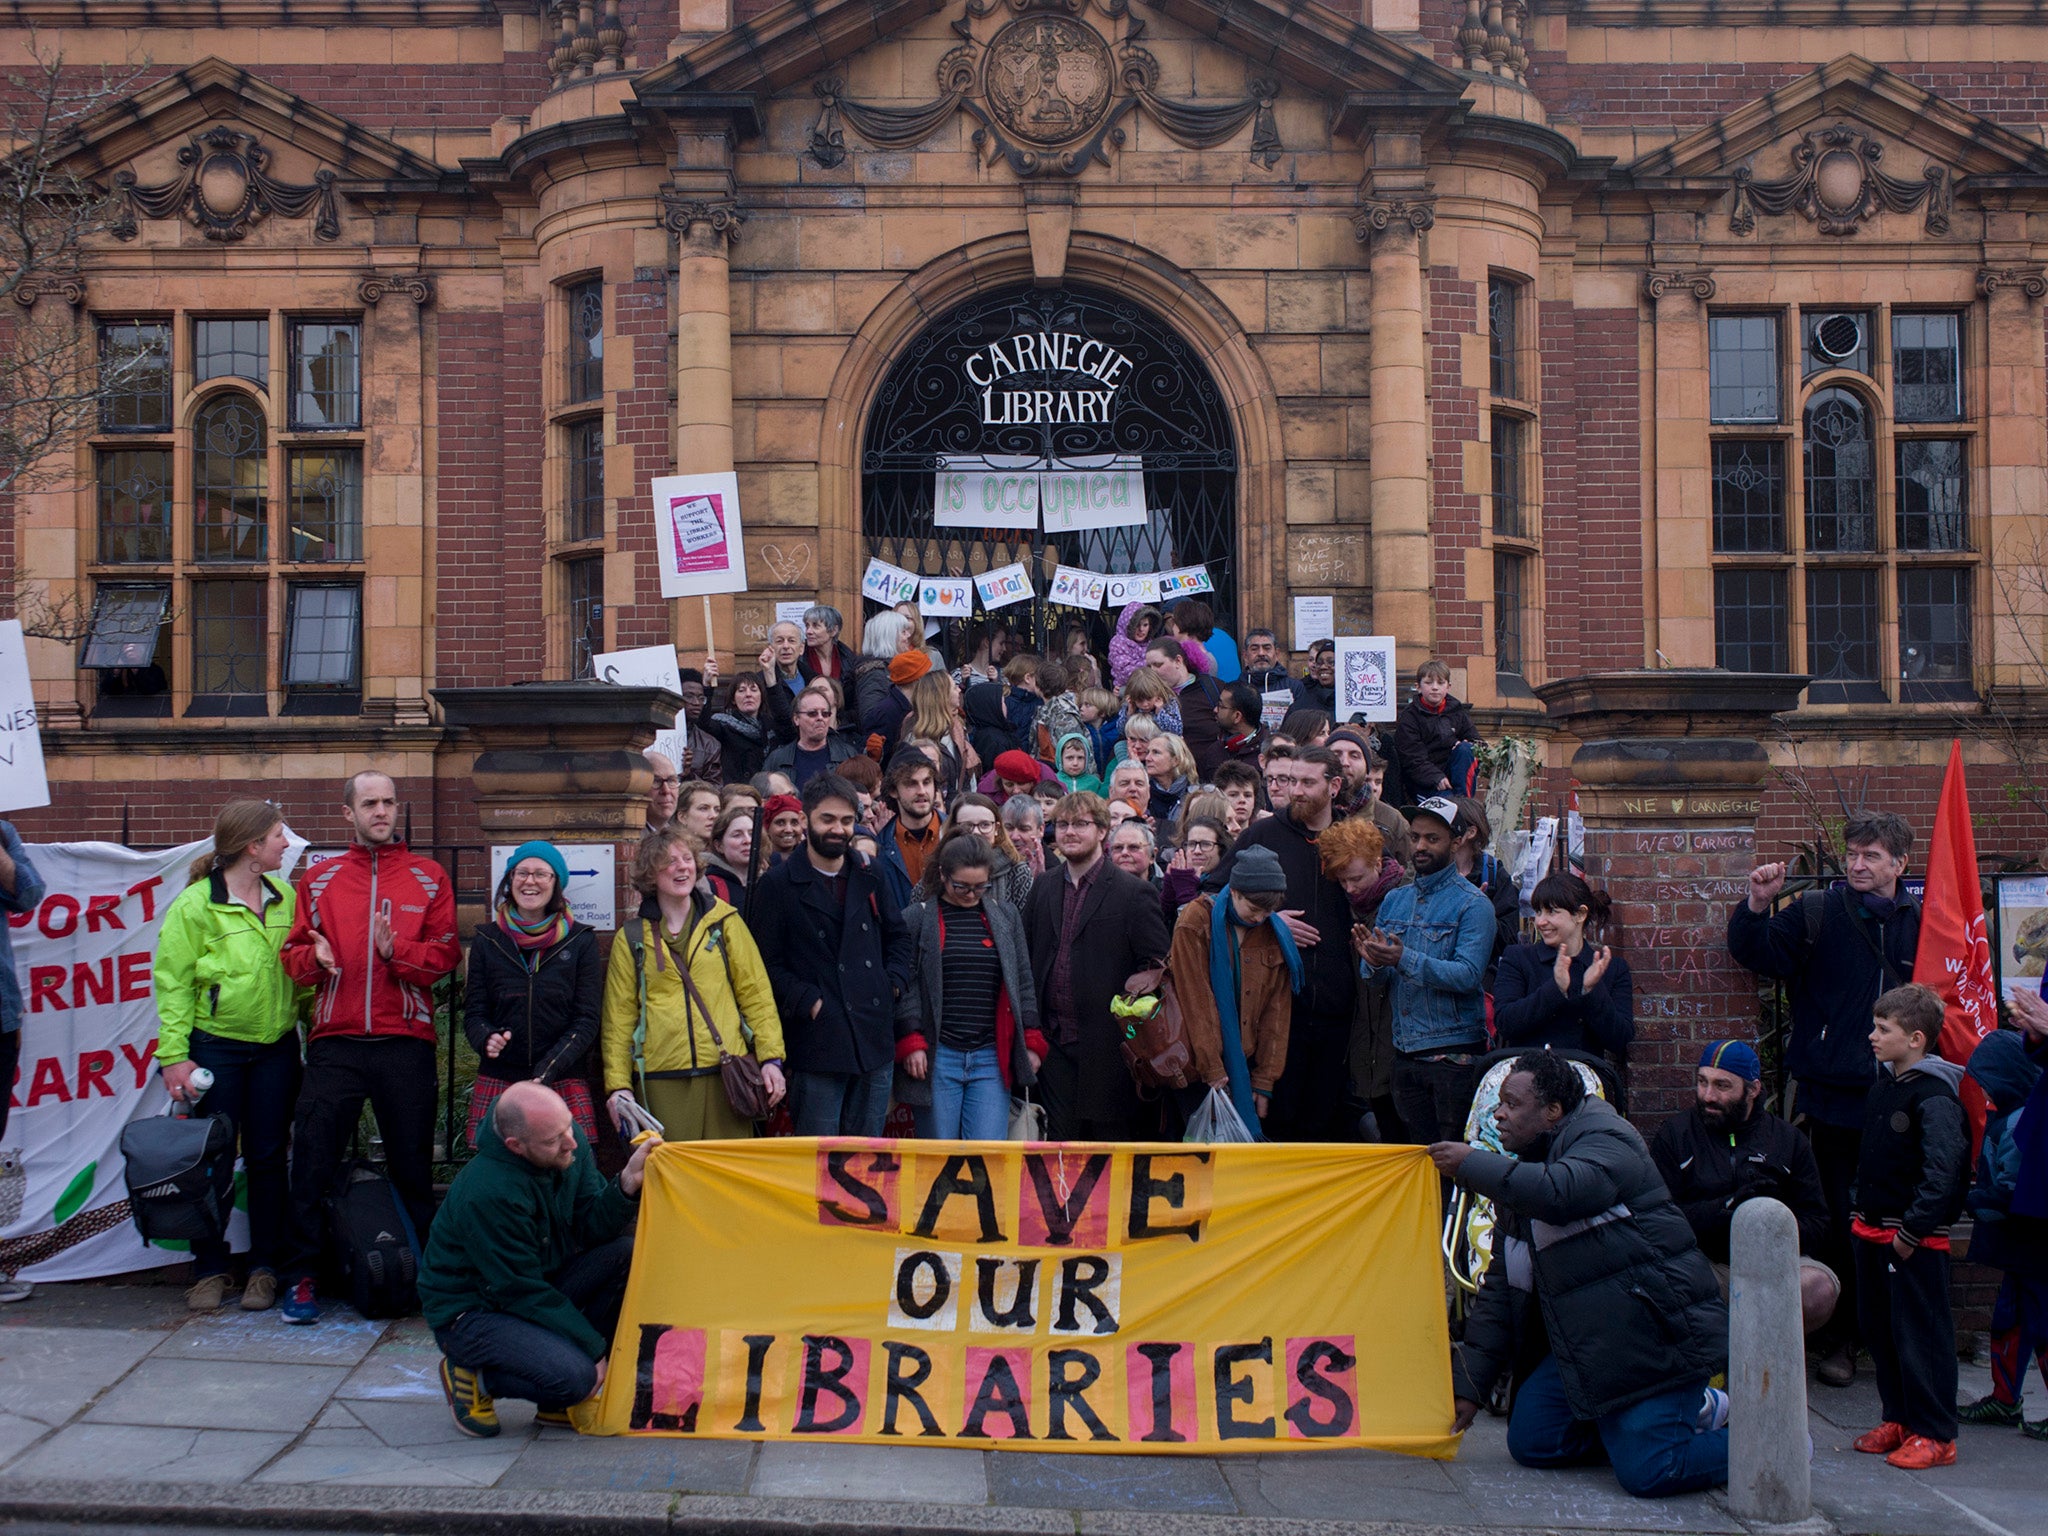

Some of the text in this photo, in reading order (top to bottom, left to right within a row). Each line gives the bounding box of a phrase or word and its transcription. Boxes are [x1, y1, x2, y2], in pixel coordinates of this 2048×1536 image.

[966, 332, 1133, 390] CARNEGIE
[982, 385, 1115, 424] LIBRARY
[680, 507, 708, 520] SUPPORT
[690, 518, 704, 526] THE
[686, 523, 713, 536] LIBRARY
[686, 530, 718, 543] WORKERS
[1297, 560, 1344, 574] NEED
[923, 586, 968, 608] OUR
[1111, 580, 1155, 598] OUR
[1357, 674, 1378, 684] SAVE
[1623, 799, 1761, 813] WE CARNEGIE
[1636, 832, 1668, 852] WE
[569, 902, 597, 910] arden
[587, 911, 611, 920] Road
[1633, 927, 1677, 949] WE
[23, 951, 152, 1013] RNE
[817, 1151, 1211, 1244] SAVE
[897, 1251, 1120, 1334] OUR
[629, 1324, 1356, 1441] LIBRARIES
